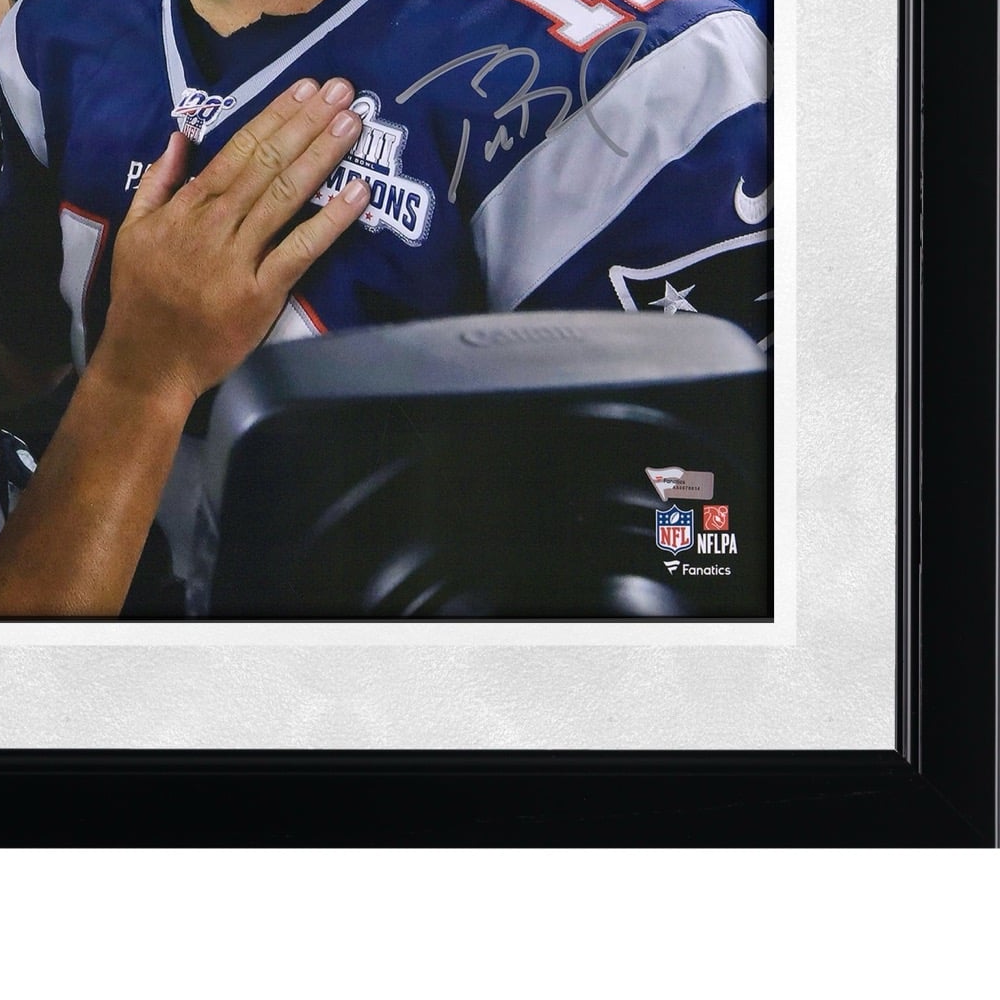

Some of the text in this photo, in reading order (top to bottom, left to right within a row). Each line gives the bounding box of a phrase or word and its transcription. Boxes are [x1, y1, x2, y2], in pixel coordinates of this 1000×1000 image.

[660, 527, 690, 548] NFL
[697, 533, 738, 554] NFLPA
[682, 564, 732, 576] Fanatics
